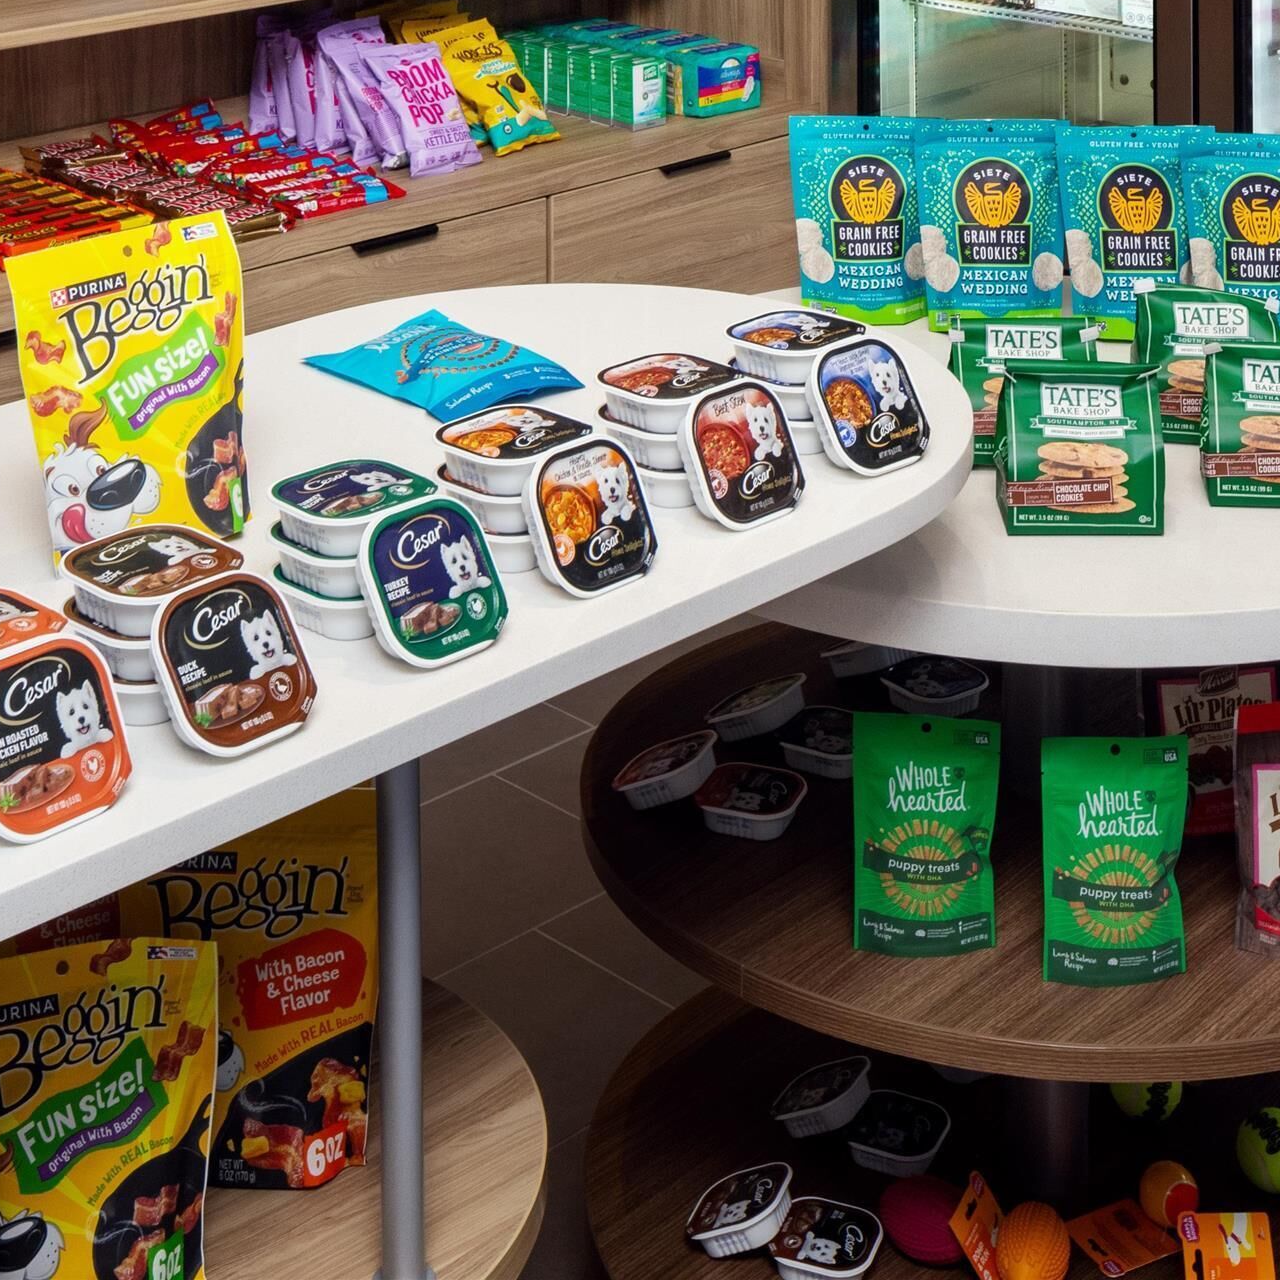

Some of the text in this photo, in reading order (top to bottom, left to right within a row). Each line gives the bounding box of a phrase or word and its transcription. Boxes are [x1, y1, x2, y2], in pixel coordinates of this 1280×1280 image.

[387, 57, 442, 90] BOOM
[401, 81, 455, 109] CHICKA
[408, 104, 445, 128] POP
[1007, 136, 1035, 144] VEGAN
[1089, 141, 1180, 149] GLUTEN FREE VEGAN
[848, 165, 885, 178] SIETE
[973, 168, 1011, 181] SIETE
[839, 225, 900, 240] GRAIN FREE
[964, 230, 1026, 244] GRAIN FREE
[848, 241, 893, 256] COOKIES
[1108, 236, 1171, 250] GRAIN FREE
[973, 246, 1018, 261] COOKIES
[1117, 252, 1163, 267] COOKIES
[838, 264, 901, 277] MEXICAN
[961, 270, 1028, 282] MEXICAN
[69, 276, 124, 300] PURINA
[839, 276, 904, 290] WEDDING
[961, 283, 1028, 296] WEDDING
[58, 253, 213, 385] Beggin'
[1178, 306, 1245, 327] TATE'S
[136, 365, 211, 422] Original With Bacon
[1255, 384, 1280, 393] BAKE
[1044, 386, 1118, 408] TATE'S
[1054, 407, 1110, 416] BAKE SHOP
[1056, 483, 1109, 494] CHOCOLATE CHIP
[397, 521, 444, 562] Cesar
[384, 577, 410, 593] TURKEY
[387, 588, 411, 602] RECIPE
[178, 660, 199, 675] DUCK
[3, 664, 63, 717] Cesar
[5, 724, 40, 748] ROASTED
[20, 732, 49, 754] FLAVOR
[1164, 751, 1178, 762] USA
[895, 760, 952, 792] WHOLE
[887, 775, 968, 813] hearted
[1085, 785, 1142, 818] WHOLE
[1077, 803, 1160, 838] hearted
[888, 858, 960, 874] puppy treats
[1079, 886, 1153, 901] puppy treats
[256, 946, 346, 983] With Bacon
[265, 966, 341, 999] & Cheese
[280, 986, 332, 1017] Flavor
[254, 1012, 365, 1074] Made With REAL Bacon
[46, 1103, 145, 1176] Original With Bacon
